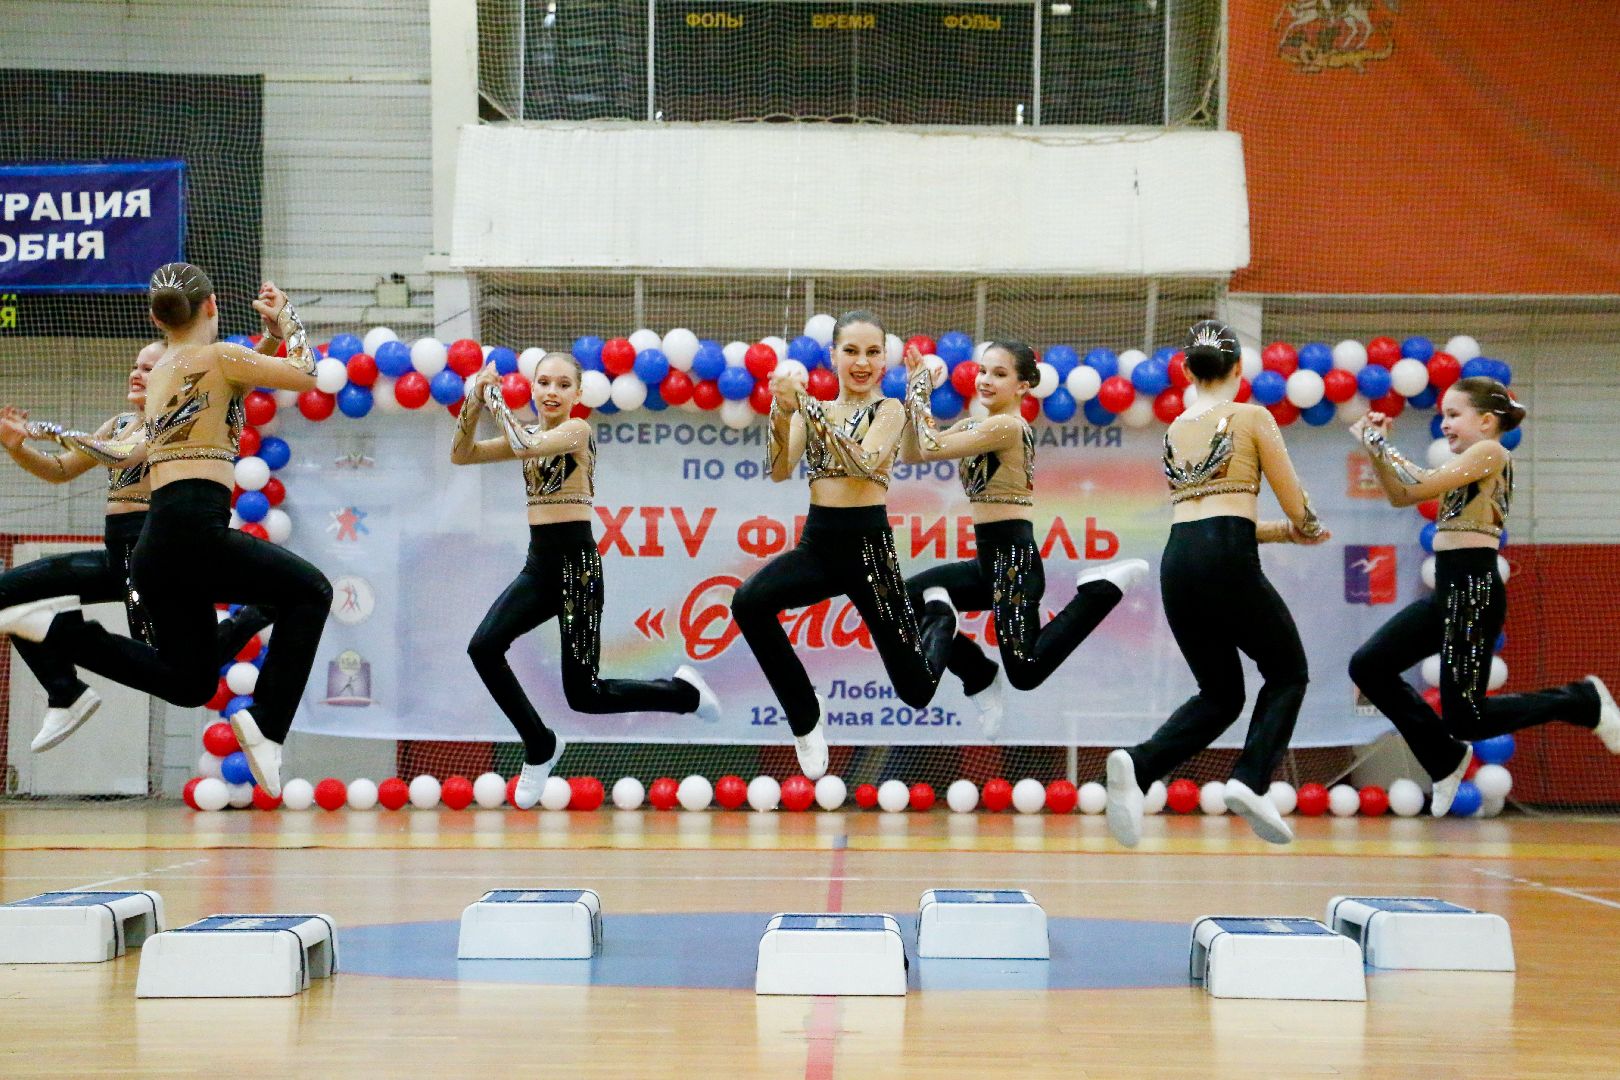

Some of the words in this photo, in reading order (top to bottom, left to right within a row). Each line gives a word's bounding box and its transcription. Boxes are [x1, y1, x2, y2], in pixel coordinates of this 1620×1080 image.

[686, 12, 743, 29] ФОЛЫ
[811, 14, 876, 30] ВРЕМЯ
[943, 15, 1002, 30] ФОЛЫ
[0, 188, 151, 226] РАЦИЯ
[597, 423, 771, 446] ВСЕРОССИ
[683, 458, 725, 480] ПО
[594, 506, 718, 558] XIV
[828, 680, 900, 700] Лобн
[827, 711, 874, 727] мая
